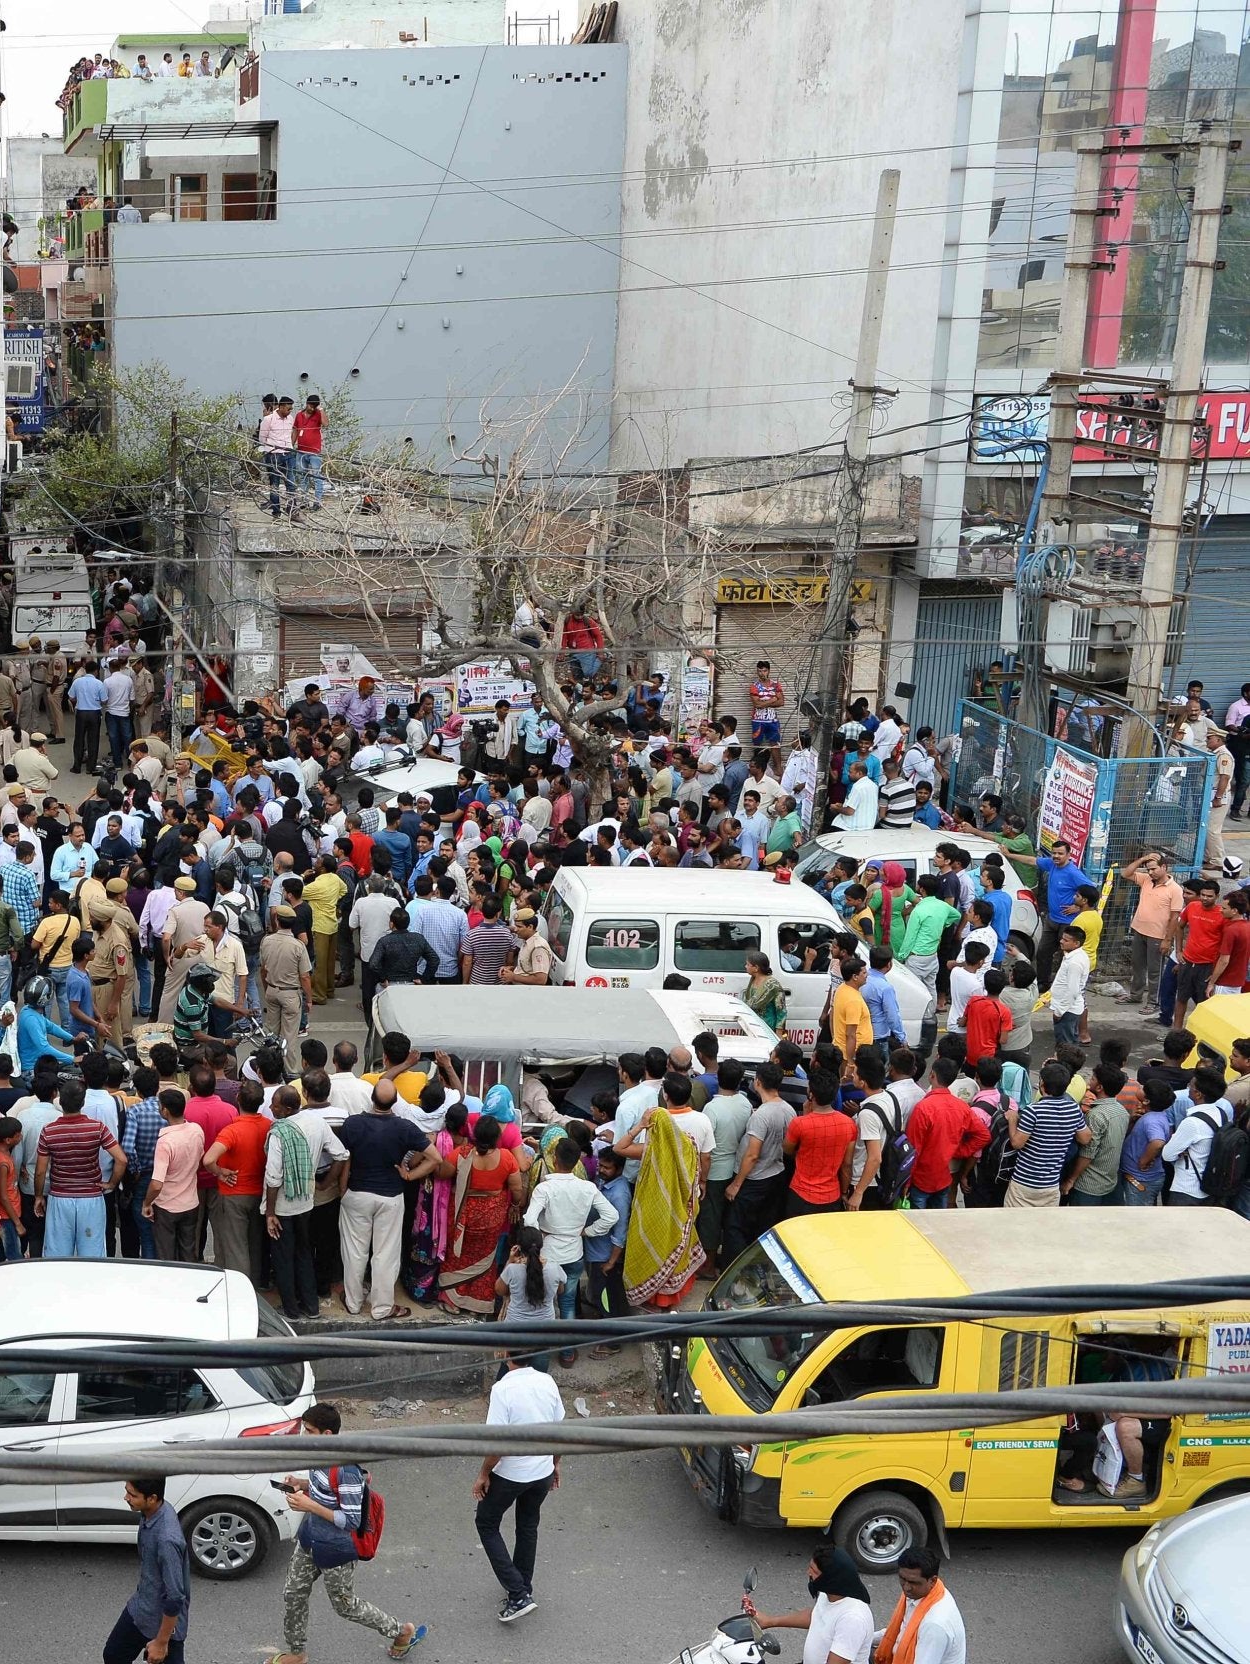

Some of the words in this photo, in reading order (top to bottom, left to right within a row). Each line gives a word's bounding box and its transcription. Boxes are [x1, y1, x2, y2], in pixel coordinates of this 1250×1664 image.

[4, 340, 39, 354] RITISH
[606, 929, 640, 948] 102
[703, 976, 724, 984] CATS
[977, 1441, 993, 1449] ECO
[994, 1440, 1032, 1449] FRIENDLY
[1034, 1440, 1055, 1448] SEWA
[1186, 1438, 1212, 1446] CNG
